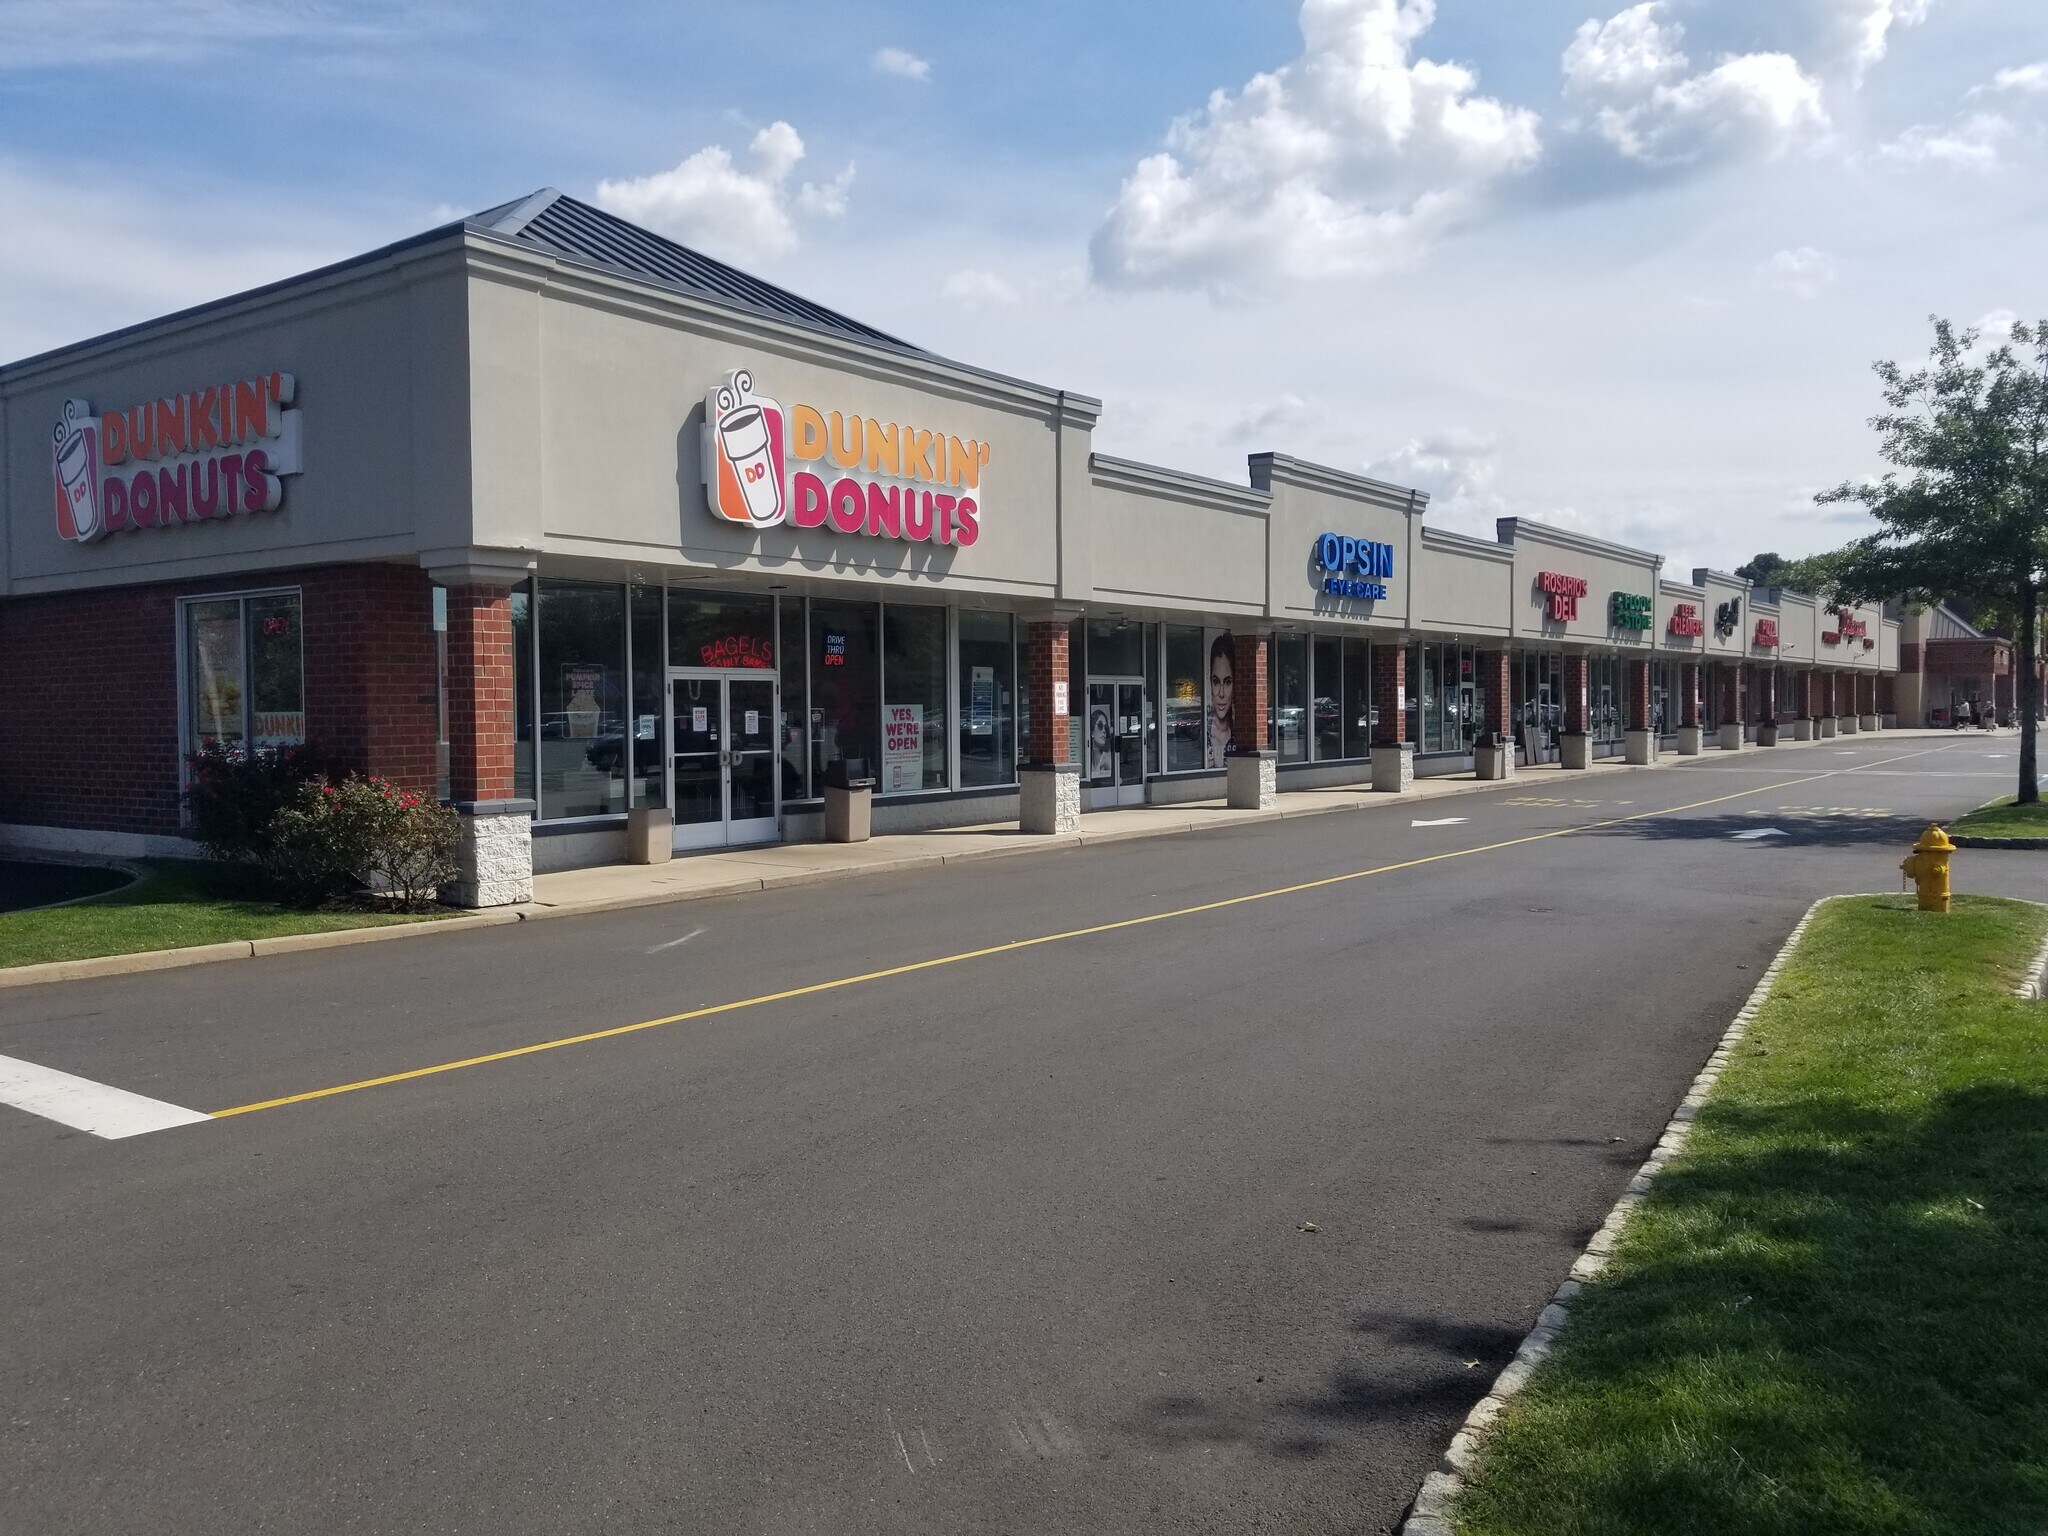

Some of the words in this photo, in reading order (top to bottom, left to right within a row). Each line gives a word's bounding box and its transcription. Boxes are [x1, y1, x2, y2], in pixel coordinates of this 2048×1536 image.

[102, 371, 281, 465] DUNKIN'
[793, 403, 990, 489] DUNKIN'
[745, 462, 765, 483] DD
[74, 480, 86, 504] DD
[103, 449, 269, 532] DONUTS
[794, 472, 979, 547] DONUTS
[1322, 532, 1393, 578] OPSIN
[1329, 578, 1353, 597] EYE
[1356, 583, 1387, 600] CARE
[1543, 572, 1588, 598] ROSARIO'S
[701, 636, 772, 664] BAGELS
[826, 645, 845, 655] THRU
[827, 635, 845, 645] DRIVE
[825, 654, 844, 666] OPEN
[891, 707, 914, 722] YES,
[886, 722, 920, 736] WE'RE
[887, 737, 918, 751] OPEN
